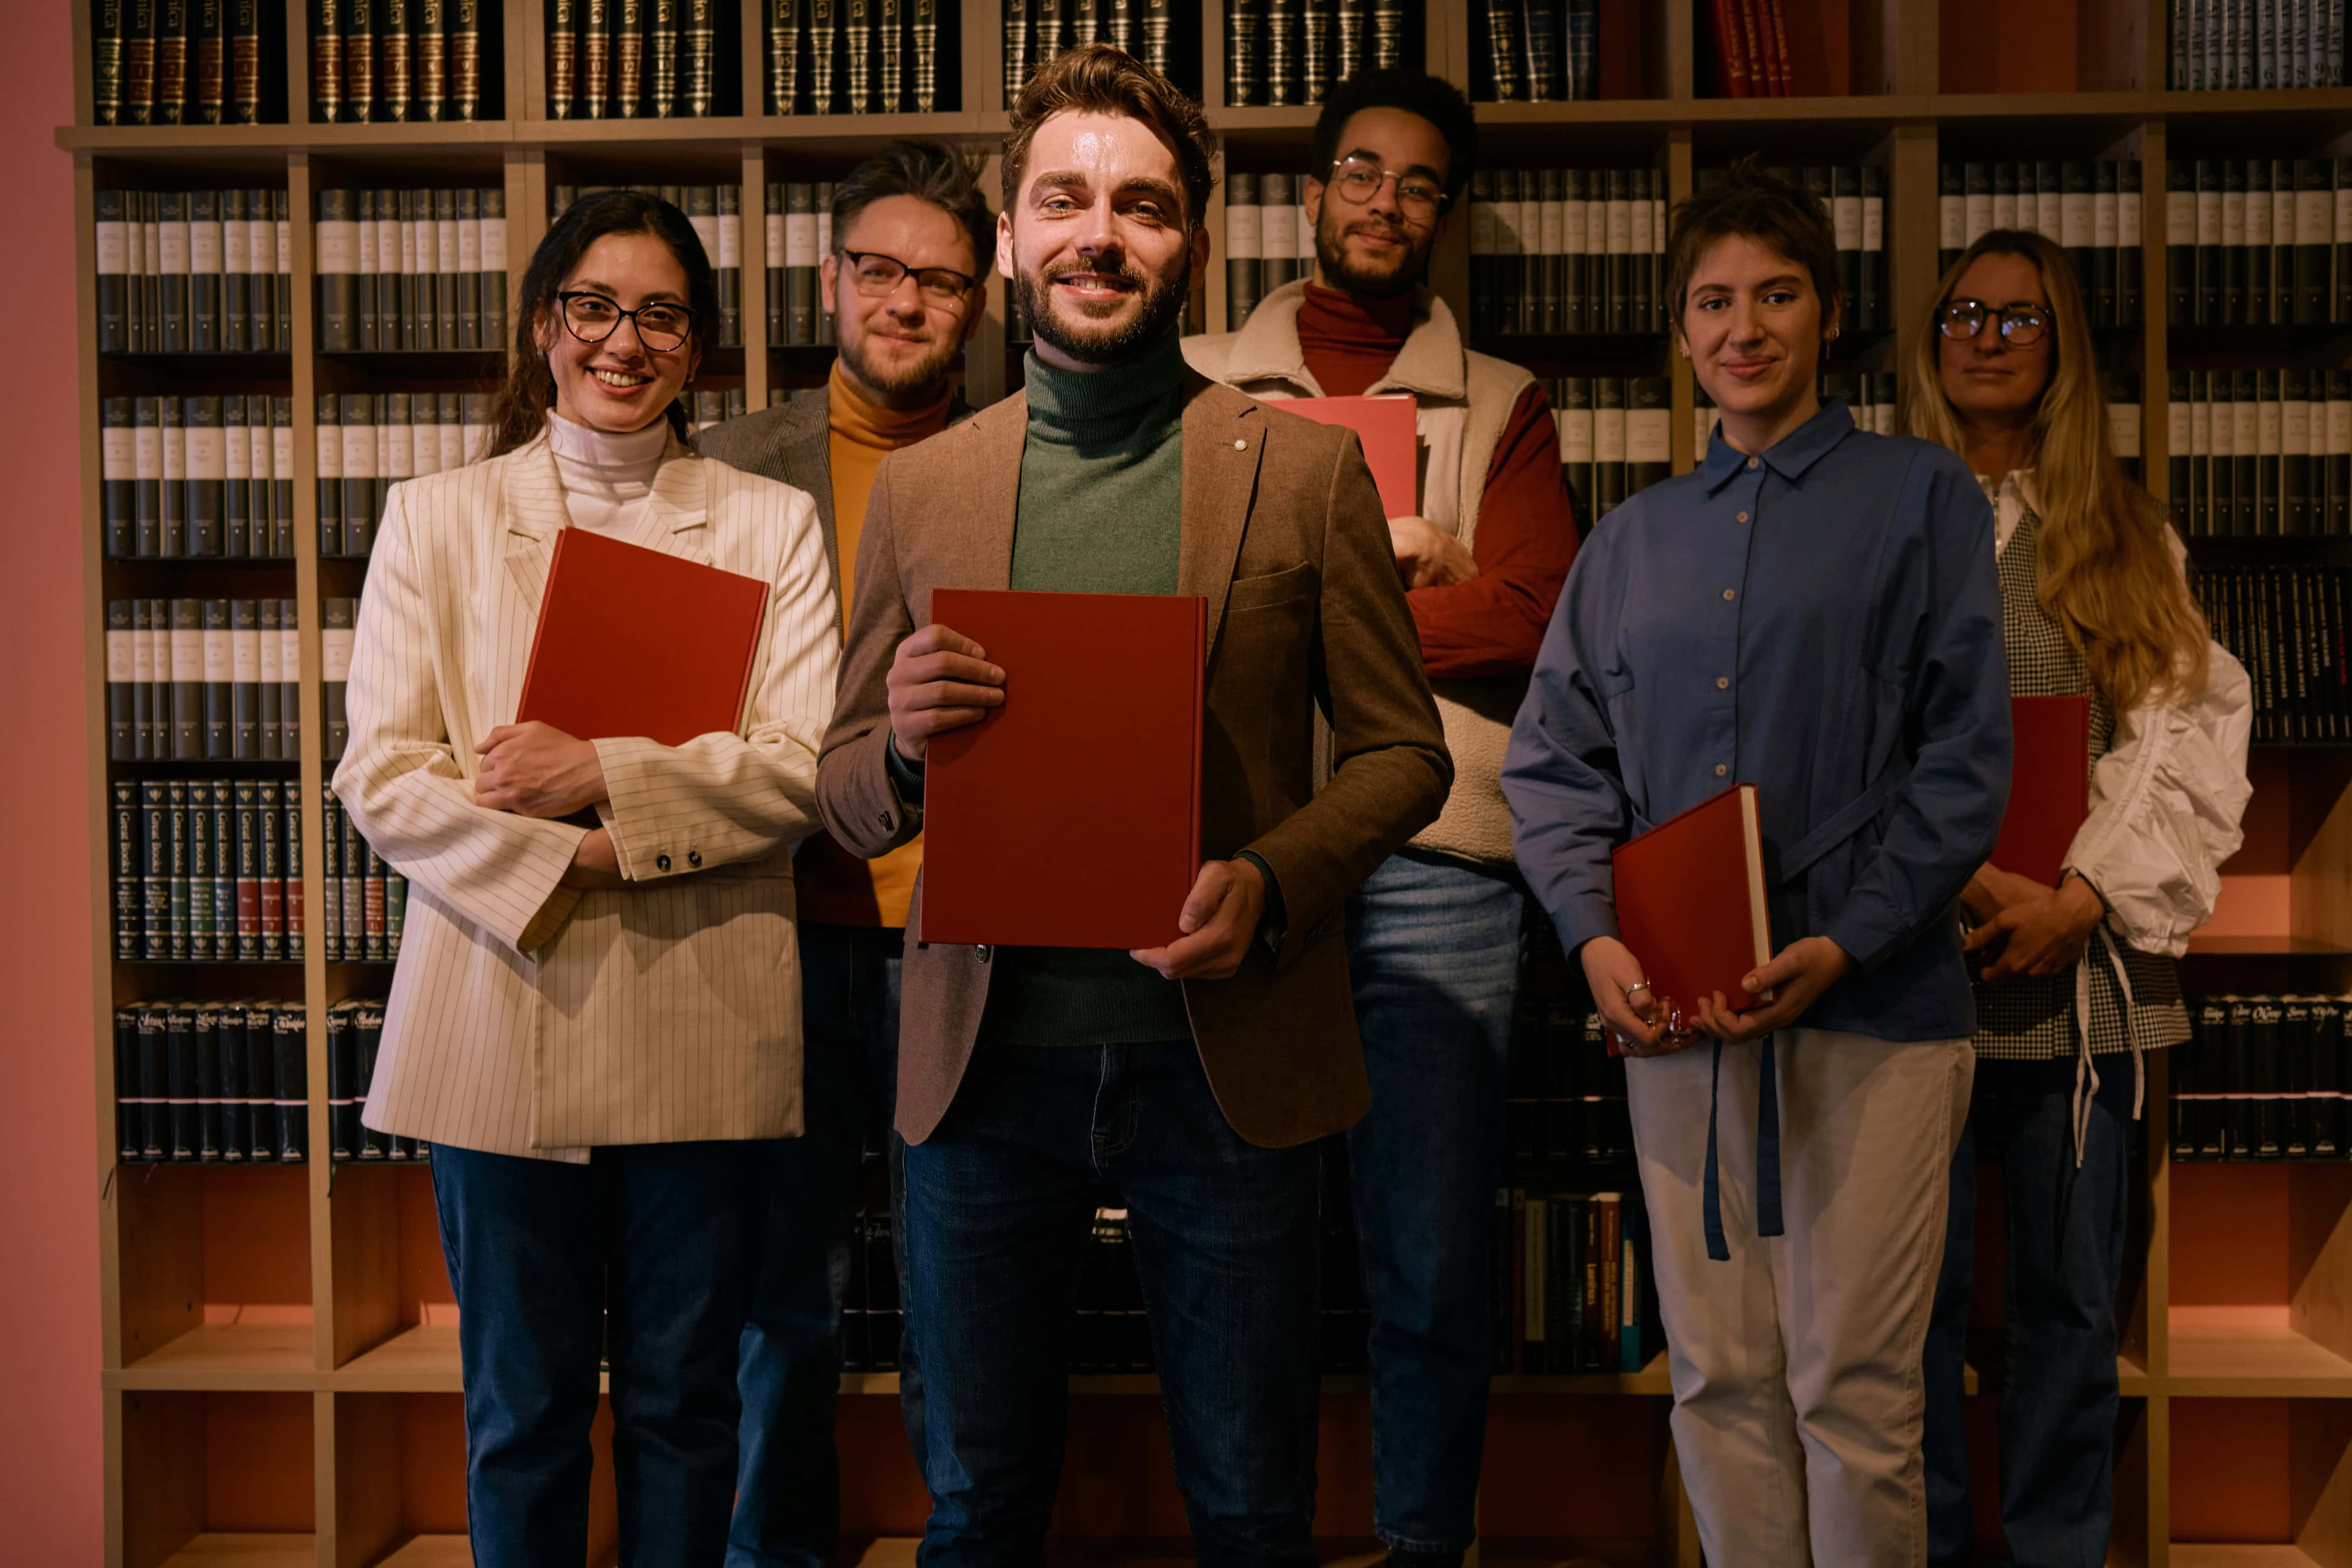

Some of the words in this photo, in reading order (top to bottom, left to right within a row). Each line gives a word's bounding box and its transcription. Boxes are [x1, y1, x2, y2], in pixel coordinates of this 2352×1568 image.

[2264, 69, 2273, 79] 6
[2283, 65, 2291, 79] 7
[121, 842, 130, 873] Books
[152, 842, 162, 873] Books
[175, 842, 184, 873] Books
[196, 842, 206, 873] Books
[219, 842, 228, 873] Books
[243, 842, 252, 873] Books
[266, 842, 276, 873] Books
[290, 842, 300, 873] Books
